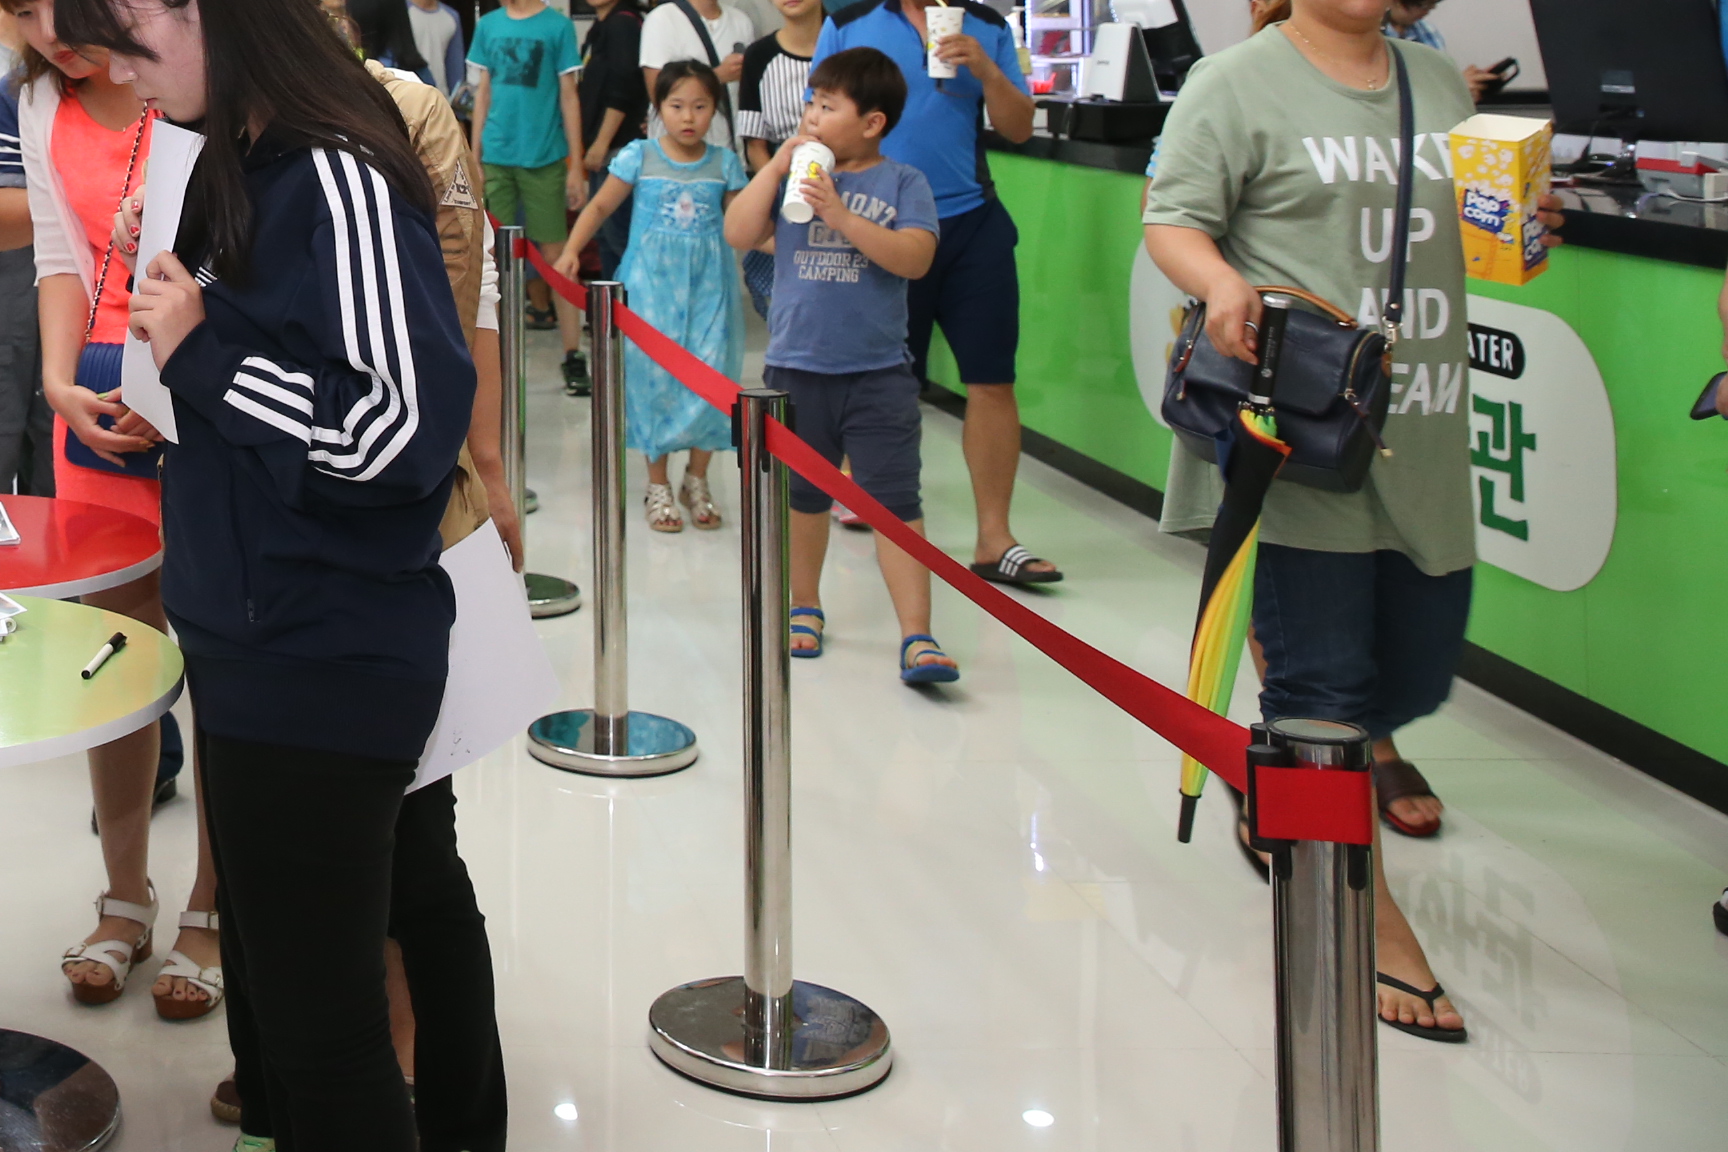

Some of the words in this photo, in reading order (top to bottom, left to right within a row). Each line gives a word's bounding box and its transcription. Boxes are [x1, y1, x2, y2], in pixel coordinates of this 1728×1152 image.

[1360, 207, 1436, 264] UP
[793, 250, 852, 268] OUTDOOR
[798, 265, 861, 284] CAMPING
